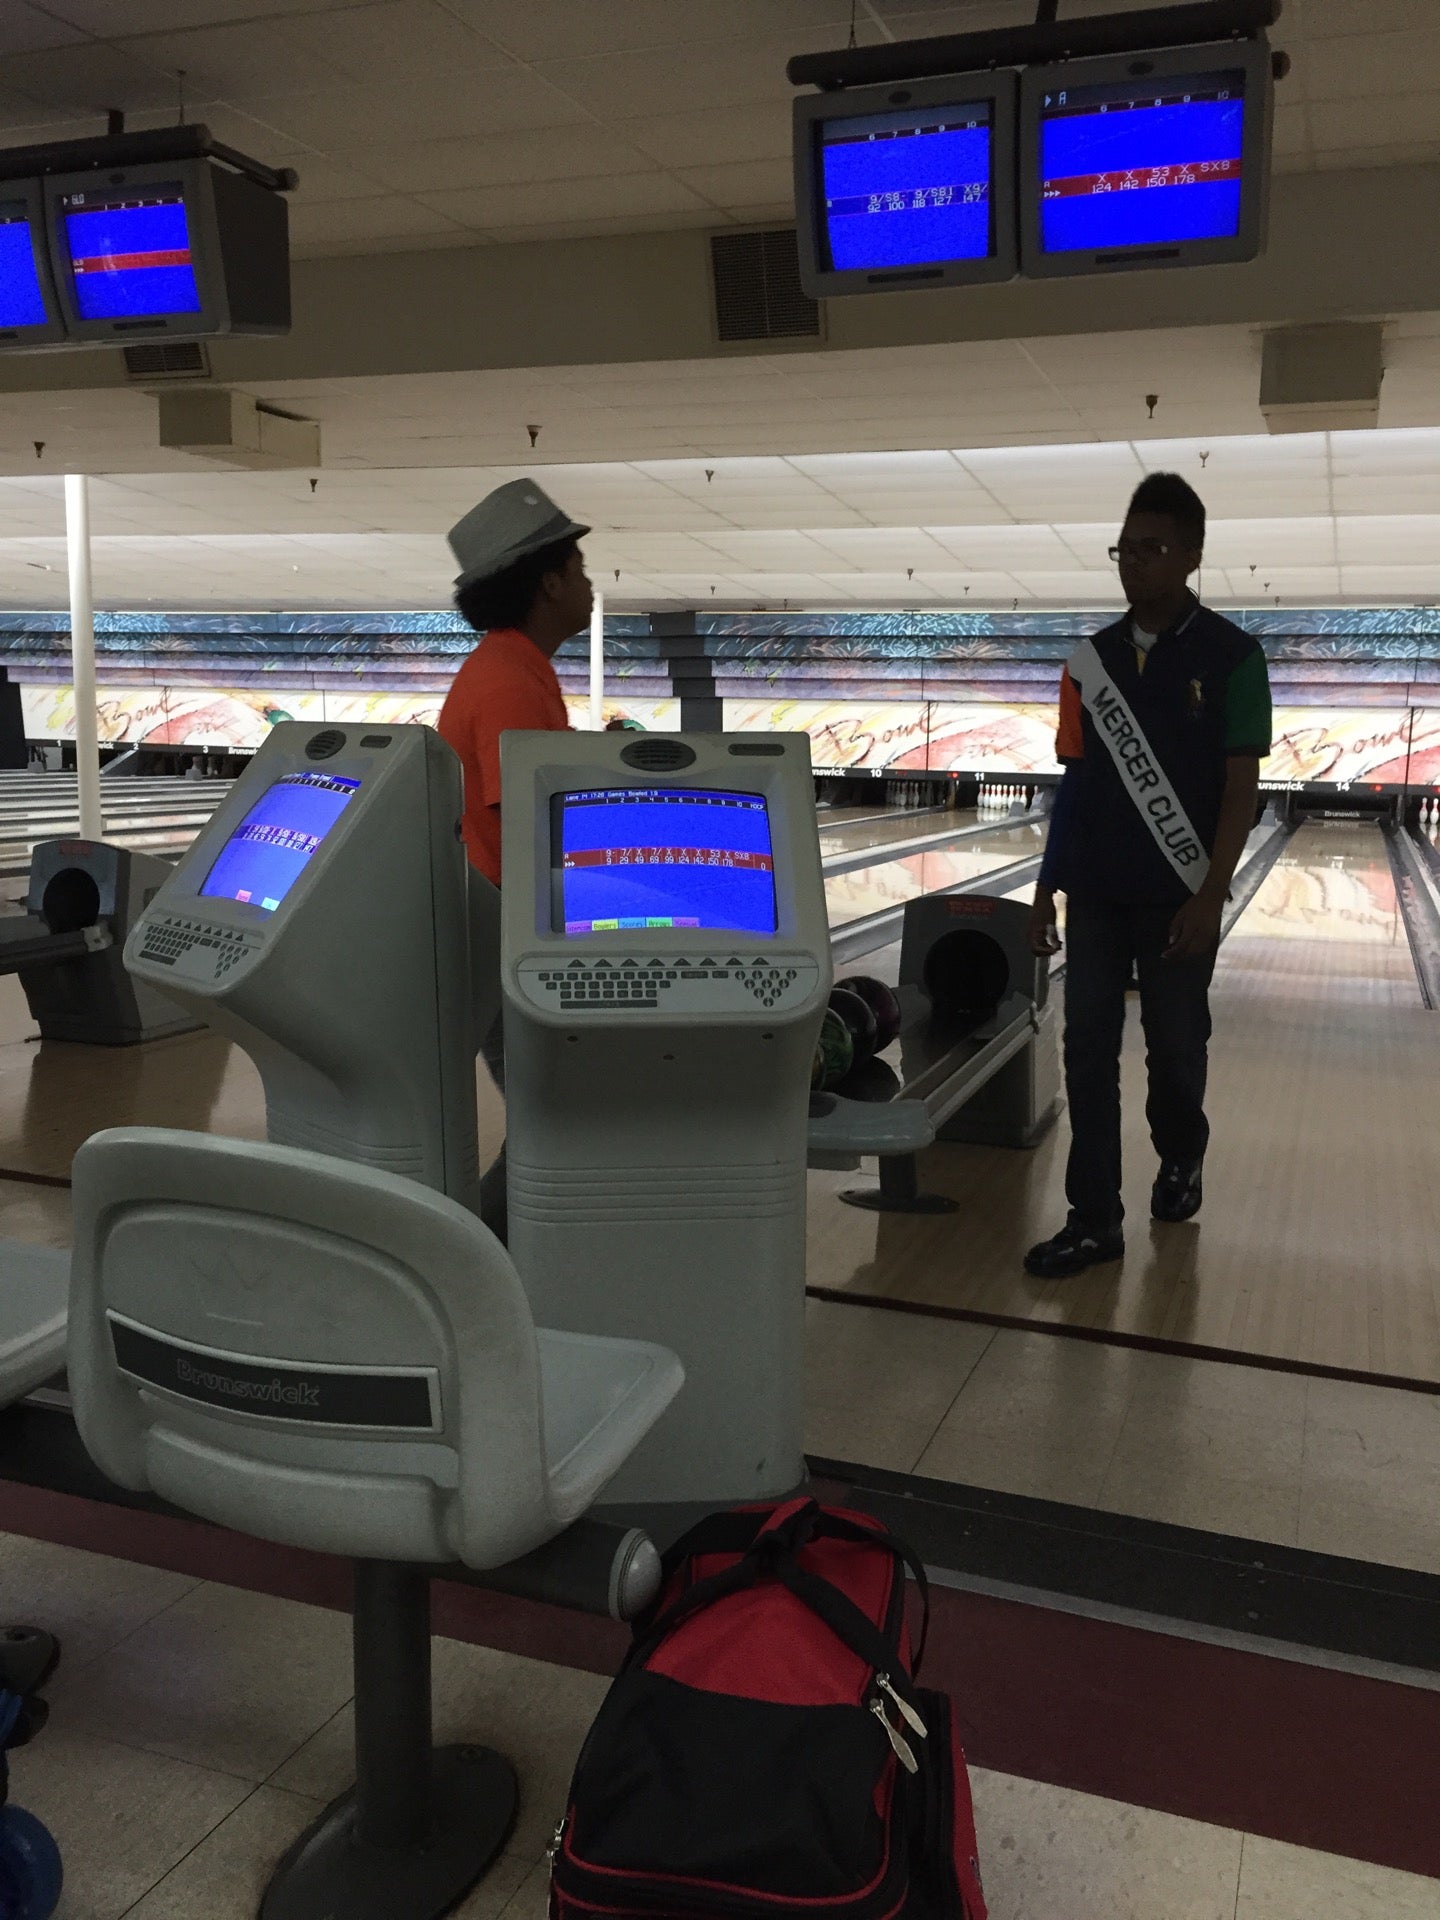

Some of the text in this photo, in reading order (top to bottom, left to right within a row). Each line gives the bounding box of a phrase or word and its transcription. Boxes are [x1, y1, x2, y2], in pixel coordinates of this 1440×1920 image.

[1058, 91, 1067, 105] A
[1100, 105, 1108, 113] 6
[1154, 98, 1162, 107] 8
[868, 133, 876, 141] 6
[914, 127, 921, 135] 8
[938, 124, 946, 132] 9
[966, 120, 977, 129] 10
[1099, 173, 1107, 183] X
[1125, 170, 1134, 180] X
[1151, 167, 1169, 177] 53
[1180, 164, 1189, 174] X
[1092, 174, 1196, 194] 124 142 150 178
[867, 193, 981, 213] 92 100 118 127 147
[202, 745, 209, 754] 3
[870, 769, 882, 778] 10
[974, 772, 985, 781] 11
[1092, 686, 1200, 867] MERCER CLUB
[1336, 782, 1350, 791] 14
[710, 849, 720, 857] 53
[650, 856, 660, 864] 69
[664, 856, 674, 864] 99
[678, 856, 689, 864] 124
[693, 857, 704, 865] 142
[707, 857, 719, 866] 150
[722, 858, 733, 867] 178
[176, 1358, 320, 1406] Brunswick
